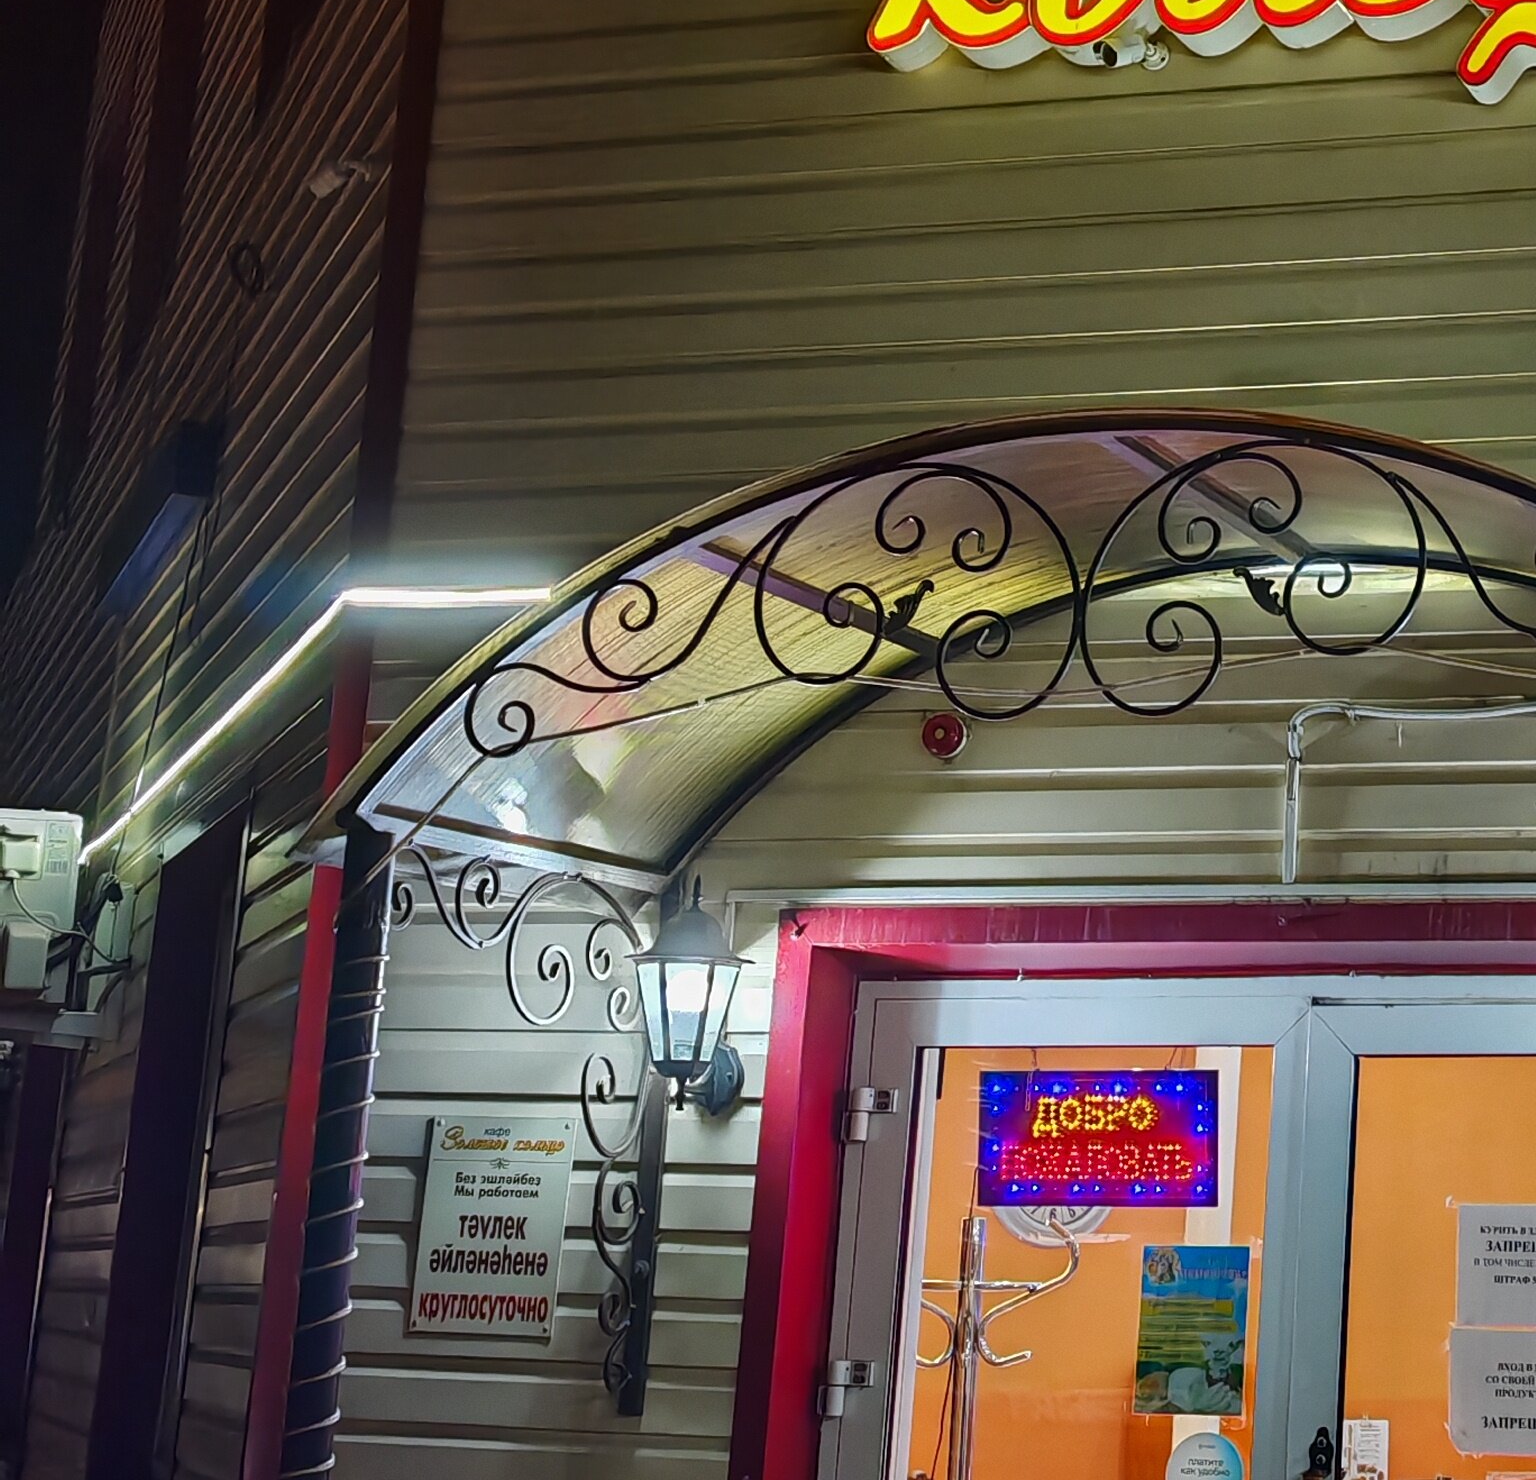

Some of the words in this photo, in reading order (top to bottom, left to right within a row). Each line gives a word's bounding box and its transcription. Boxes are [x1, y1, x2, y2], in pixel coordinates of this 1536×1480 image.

[1032, 1094, 1159, 1138] ДОБРО
[484, 1126, 511, 1138] кафе
[456, 1172, 477, 1184] Без
[454, 1186, 475, 1197] Мы
[478, 1187, 539, 1199] работаем
[1494, 1274, 1530, 1285] ШТРАФ
[418, 1292, 549, 1324] круглосуточно
[1485, 1375, 1499, 1384] СО
[1501, 1375, 1535, 1386] СВОЕЙ
[1180, 1467, 1196, 1475] как
